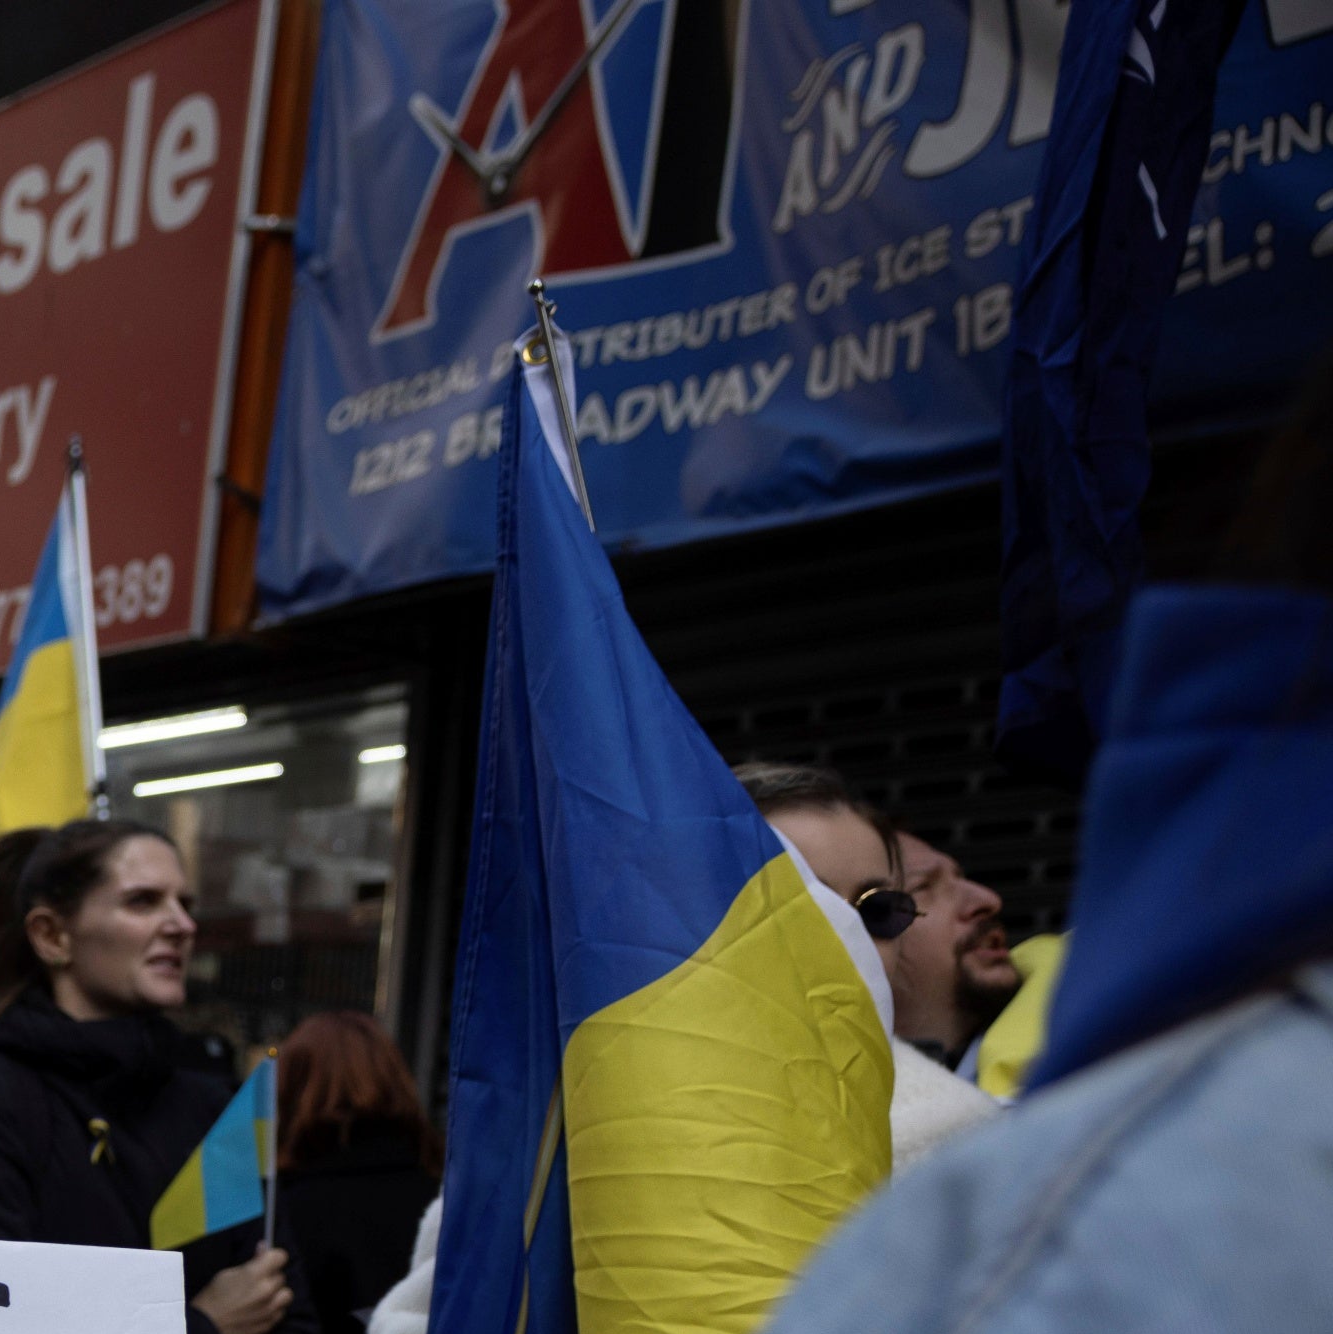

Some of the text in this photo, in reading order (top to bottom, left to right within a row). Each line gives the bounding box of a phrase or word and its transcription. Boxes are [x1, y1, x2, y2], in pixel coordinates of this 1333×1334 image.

[773, 22, 925, 234] AND
[805, 254, 863, 315] OF
[873, 224, 953, 294] ICE
[349, 430, 437, 496] 1212
[443, 353, 794, 469] BRADWAY
[804, 307, 937, 401] UNIT
